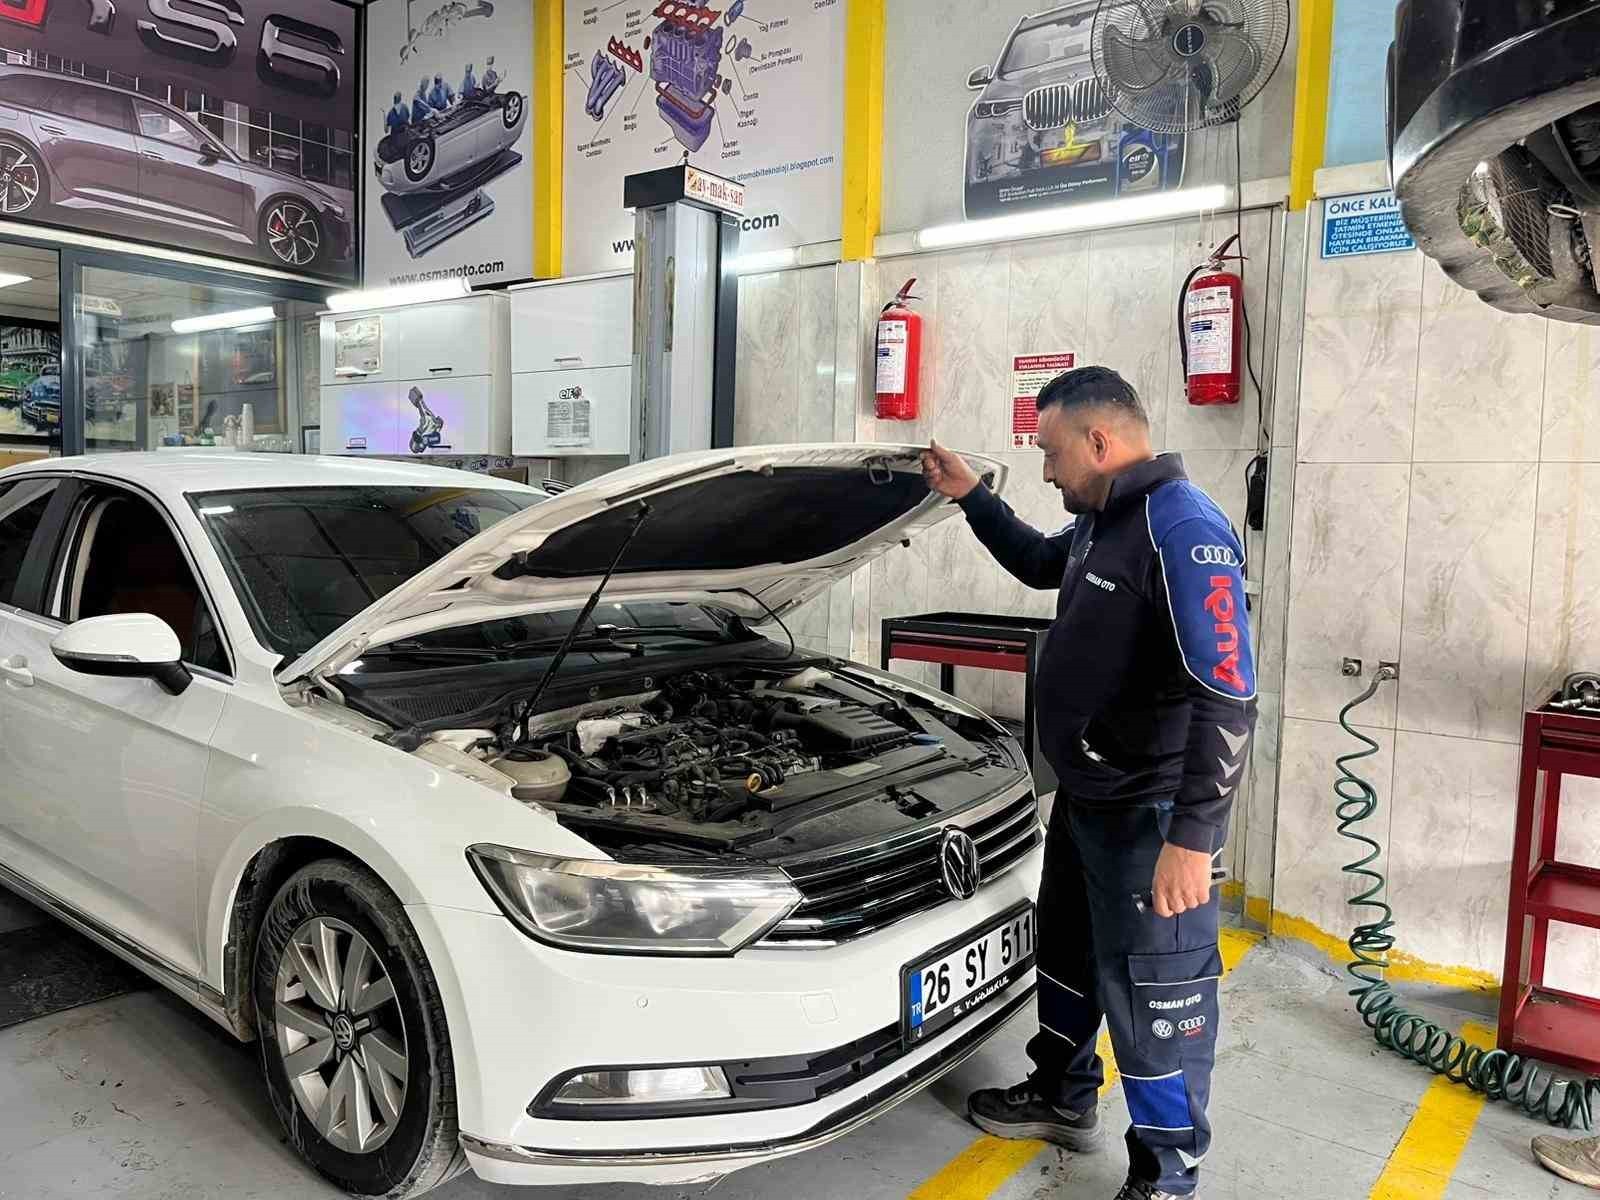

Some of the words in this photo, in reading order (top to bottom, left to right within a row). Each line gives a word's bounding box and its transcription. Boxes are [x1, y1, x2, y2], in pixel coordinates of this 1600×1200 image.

[1100, 580, 1116, 592] OTO
[1204, 575, 1247, 693] Audi
[912, 1003, 922, 1017] TR
[924, 962, 951, 1015] 26
[965, 938, 989, 988] SY
[1001, 914, 1030, 966] 511
[1149, 999, 1184, 1010] OSMAN
[1185, 993, 1202, 1007] OTO
